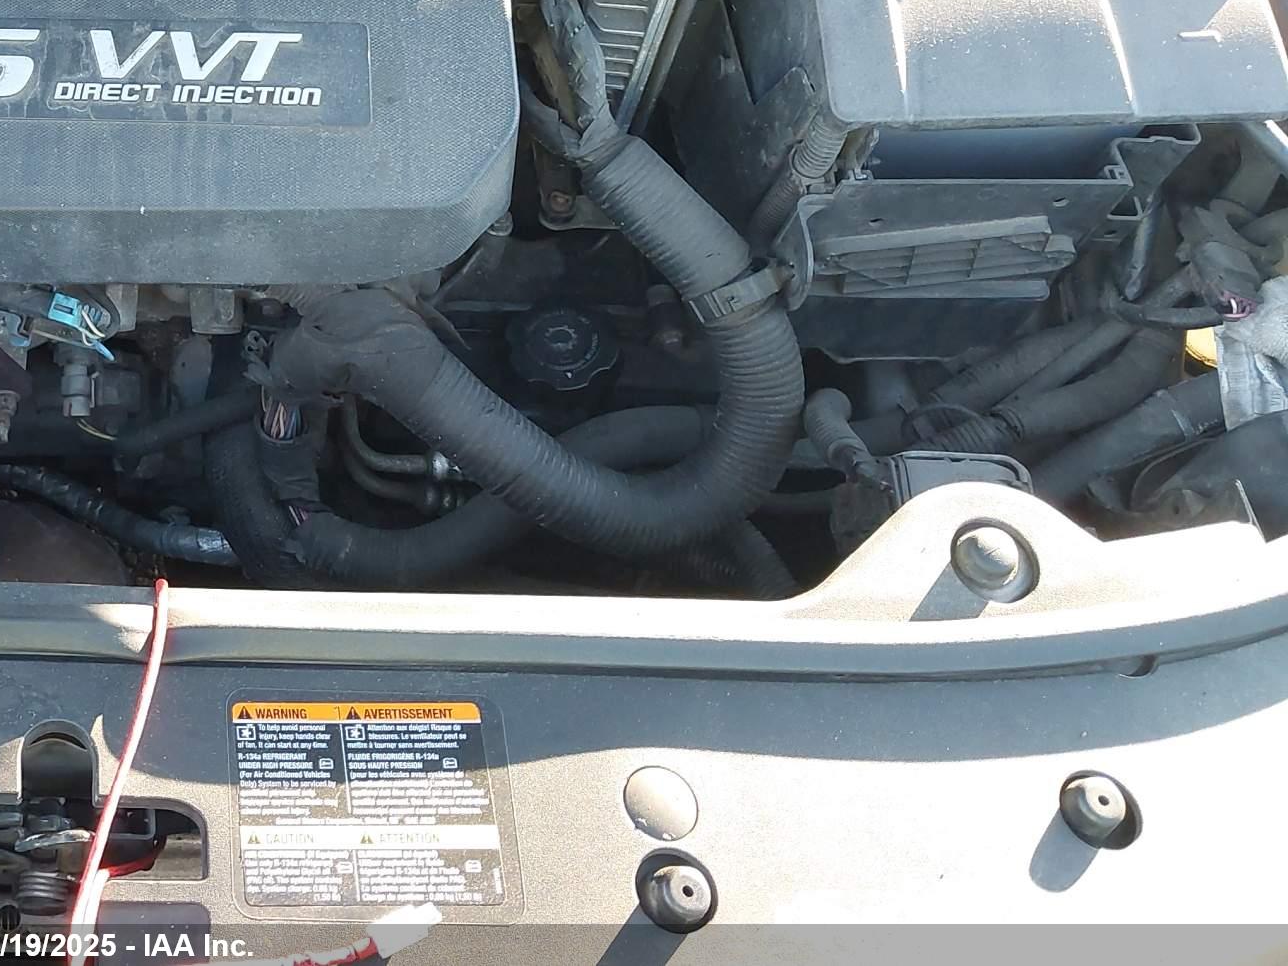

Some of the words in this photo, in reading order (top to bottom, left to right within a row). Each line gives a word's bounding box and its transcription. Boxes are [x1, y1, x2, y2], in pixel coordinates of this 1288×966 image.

[89, 29, 303, 83] VVT
[53, 81, 162, 103] DIRECT
[171, 85, 323, 107] INJECTION
[255, 708, 307, 720] WARNING
[363, 708, 453, 719] AVERTISSEMENT
[265, 833, 314, 844] CAUTION
[379, 833, 440, 843] ATTENTION
